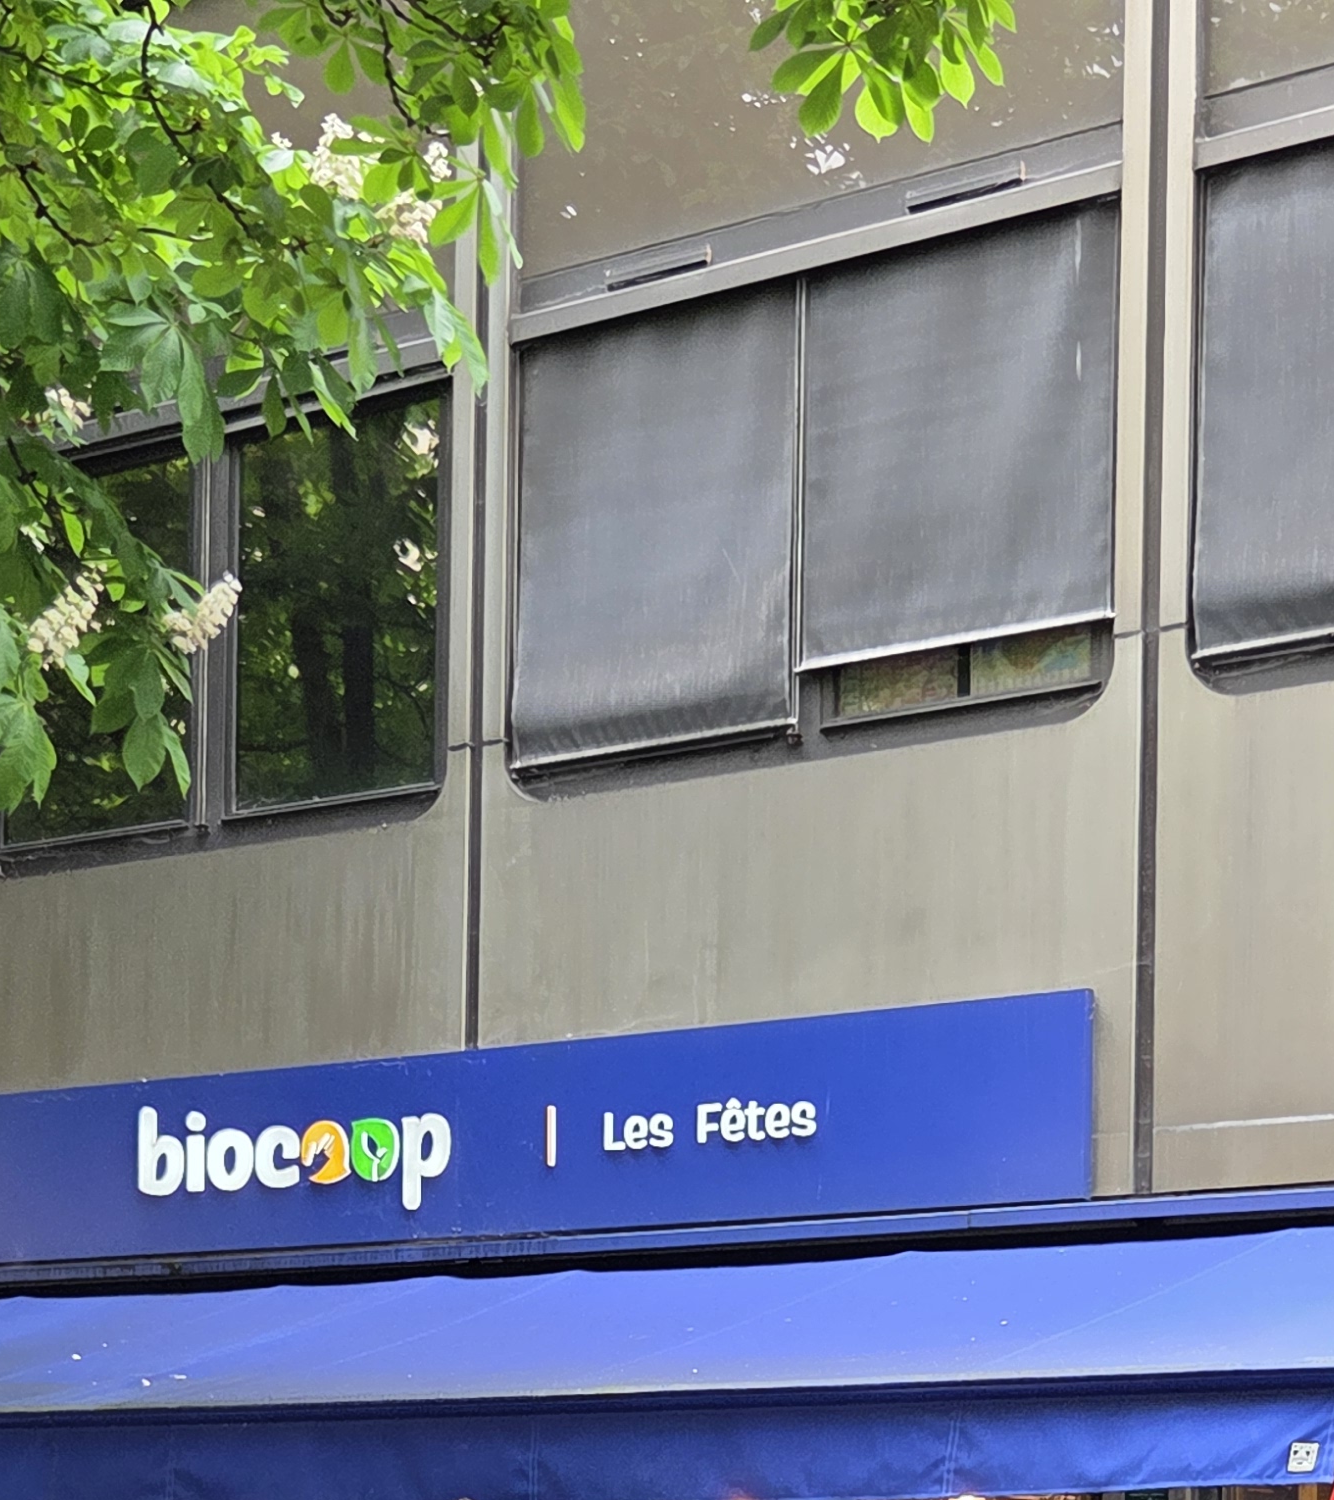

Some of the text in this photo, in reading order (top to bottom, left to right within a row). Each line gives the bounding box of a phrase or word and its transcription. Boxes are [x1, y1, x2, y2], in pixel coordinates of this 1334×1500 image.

[137, 1105, 452, 1211] biocoop
[603, 1097, 817, 1151] Les Fêtes
